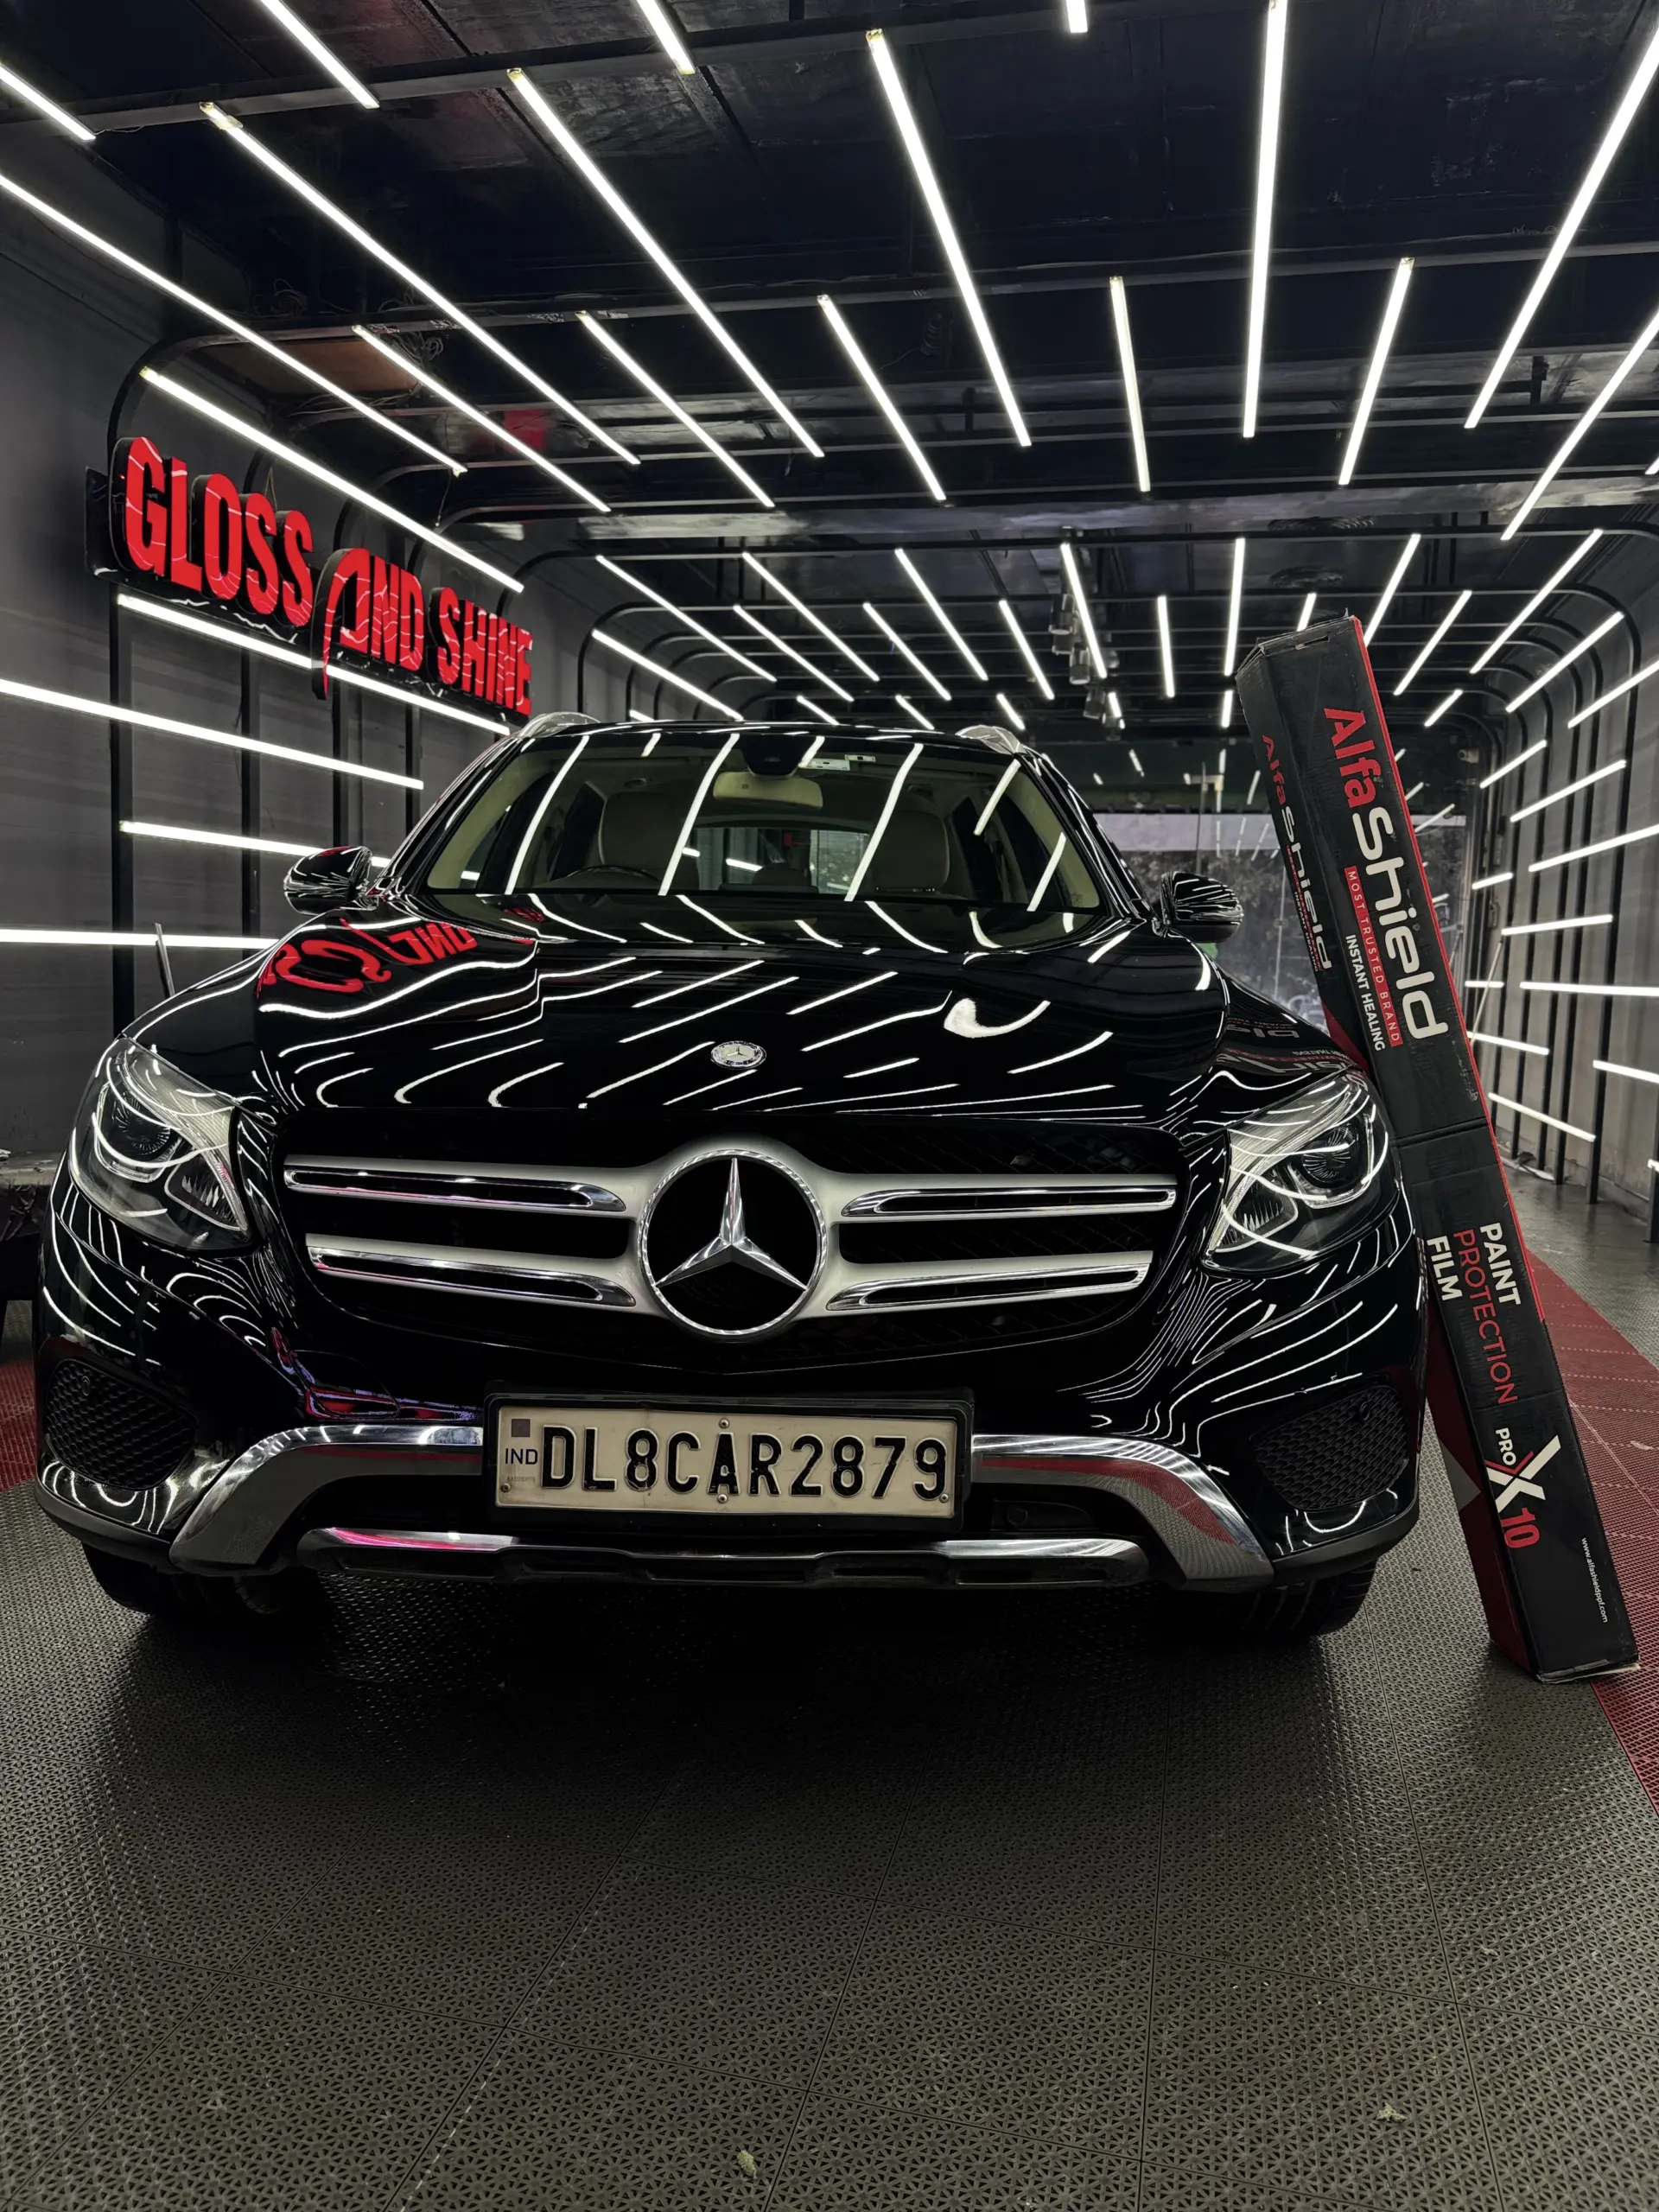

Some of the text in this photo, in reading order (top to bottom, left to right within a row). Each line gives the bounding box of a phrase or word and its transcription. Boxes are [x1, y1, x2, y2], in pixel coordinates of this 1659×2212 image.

[124, 435, 533, 716] GLOSS AND SHINE
[1324, 708, 1449, 1039] AlfaShield
[1345, 934, 1386, 1052] INSTANT HEALING
[1348, 870, 1401, 1042] MOST TRUSTED BRAND
[1427, 1235, 1463, 1301] FILM
[1479, 1222, 1521, 1306] PAINT
[1452, 1229, 1518, 1404] PROTECTION
[505, 1447, 538, 1465] IND
[541, 1424, 948, 1502] DL8CAR2879
[1496, 1427, 1517, 1466] PRO
[1500, 1507, 1541, 1549] 10
[1581, 1537, 1608, 1624] www.alfashieldppf.com
